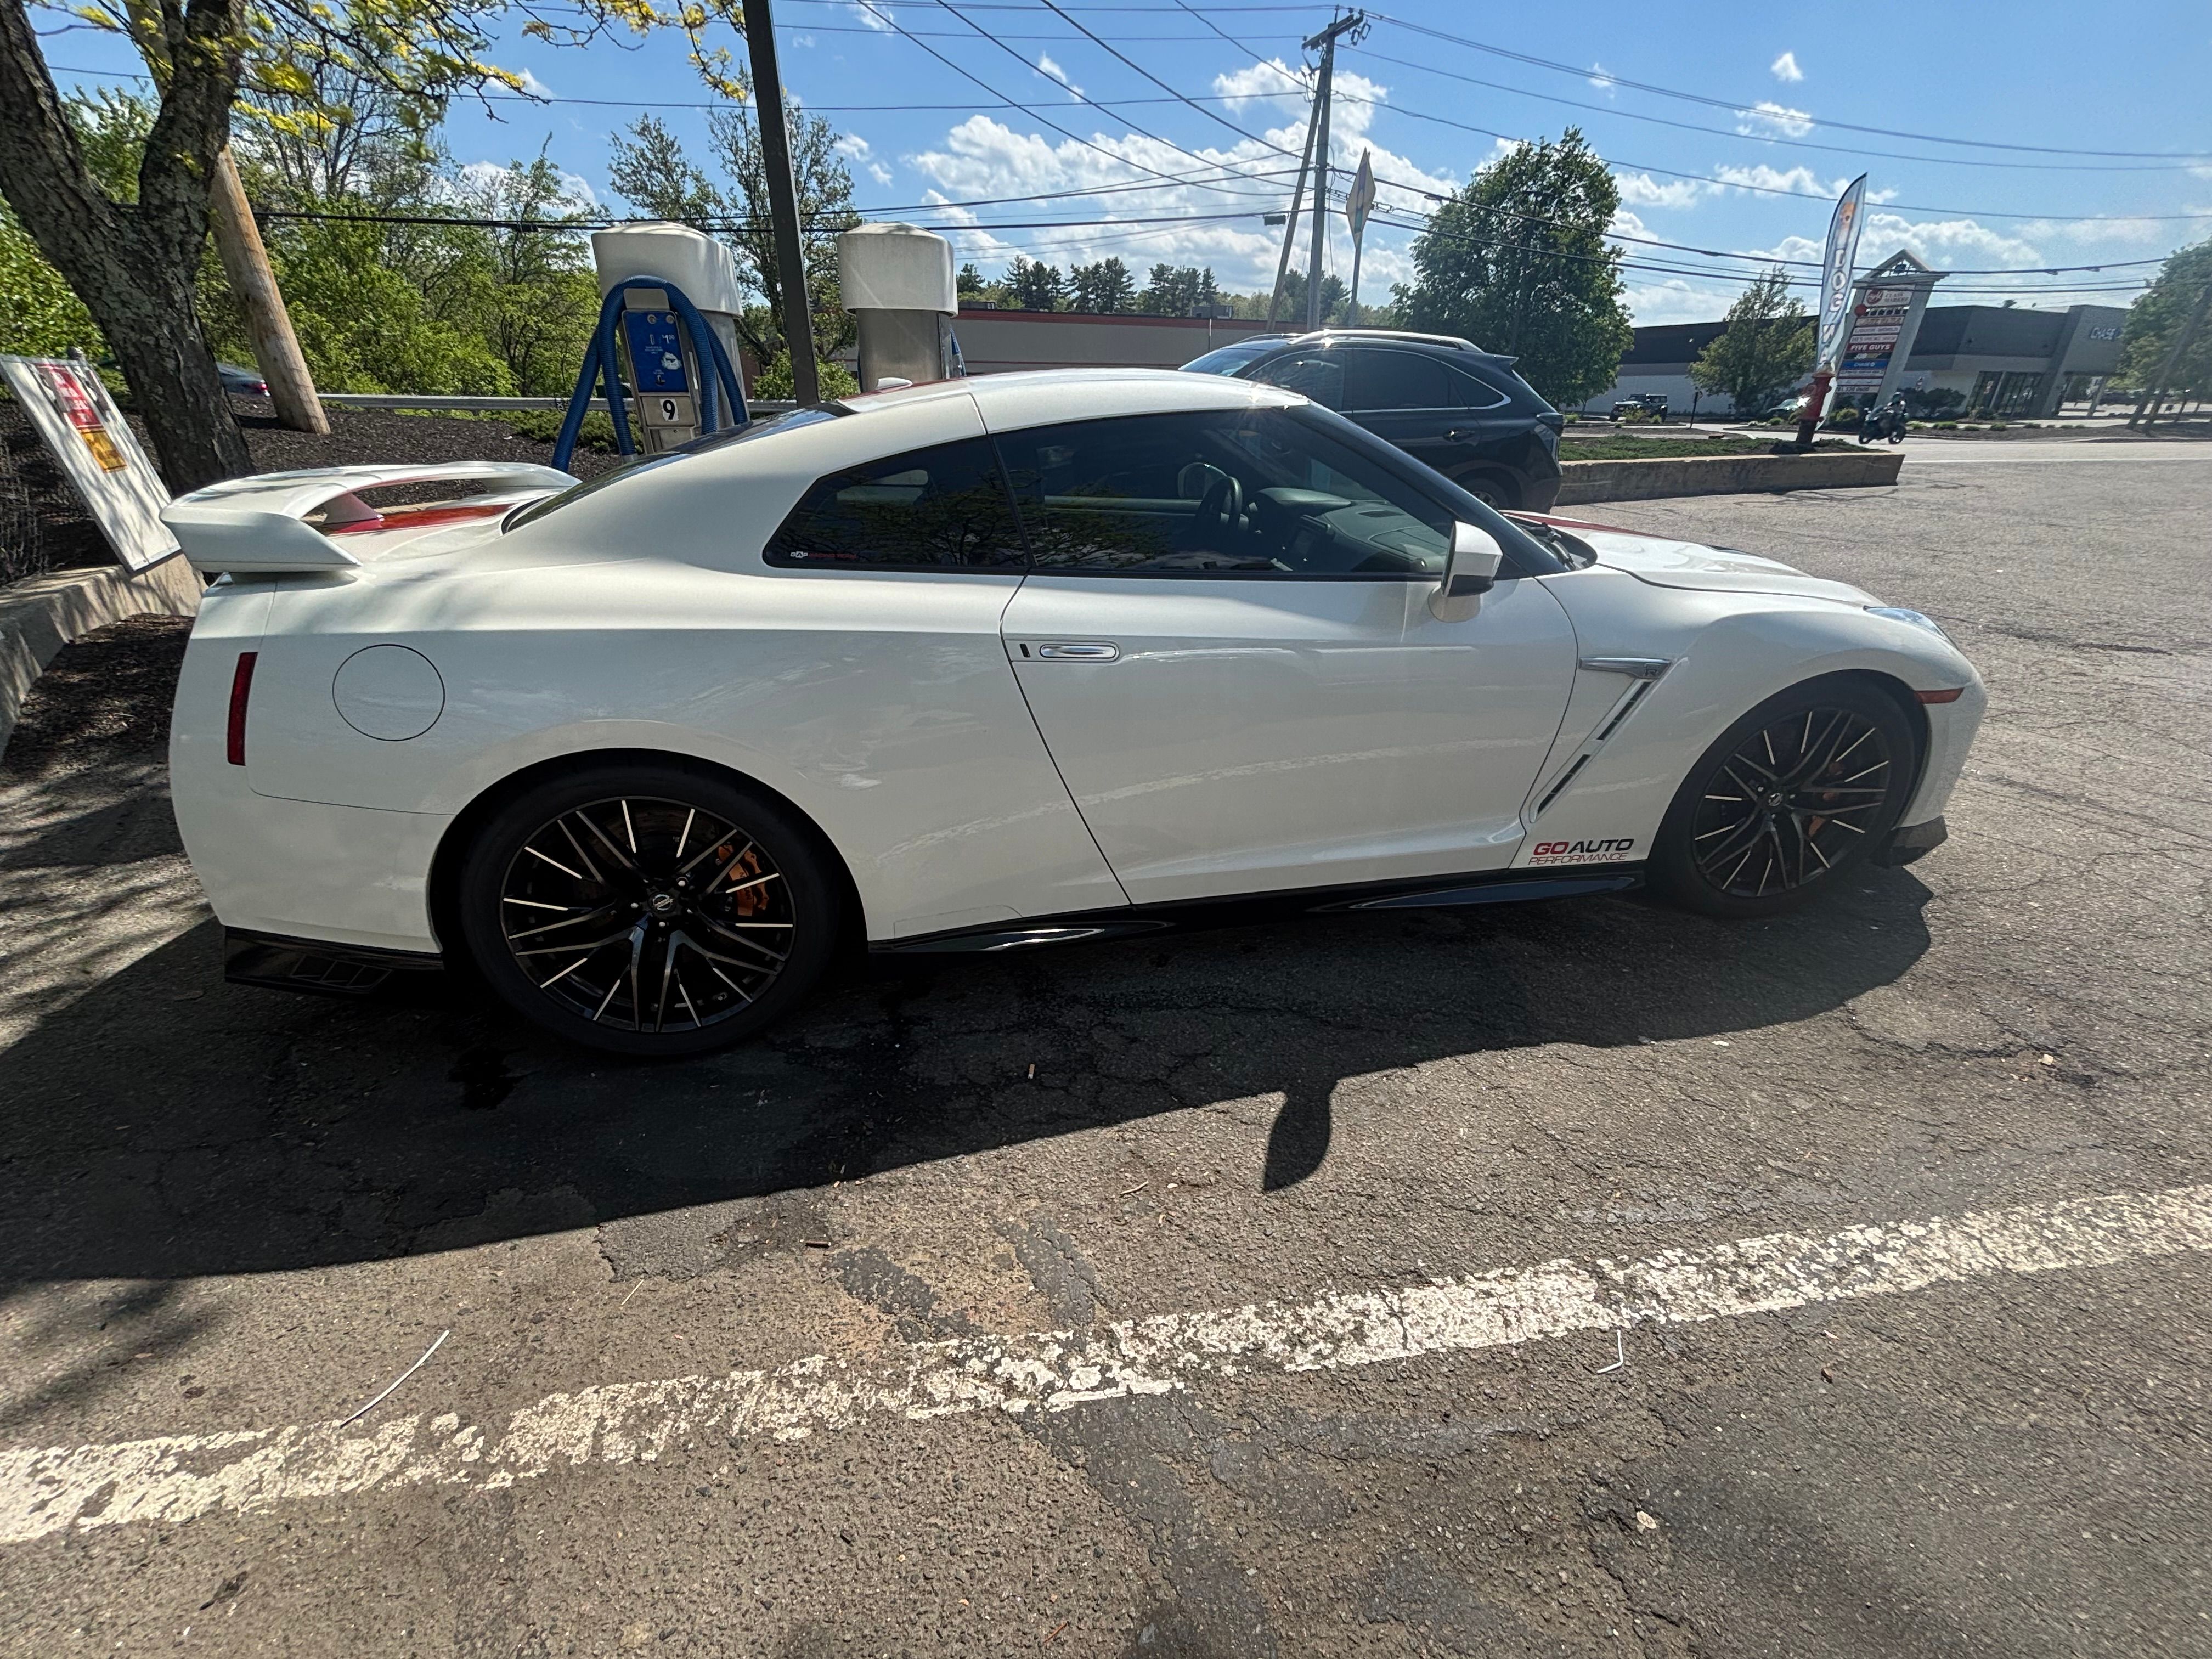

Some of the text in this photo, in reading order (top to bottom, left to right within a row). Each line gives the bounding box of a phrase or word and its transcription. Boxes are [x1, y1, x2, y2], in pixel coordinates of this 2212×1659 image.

[1830, 249, 1846, 312] DOG
[663, 400, 675, 420] 9
[1528, 852, 1629, 866] PERFORMANCE
